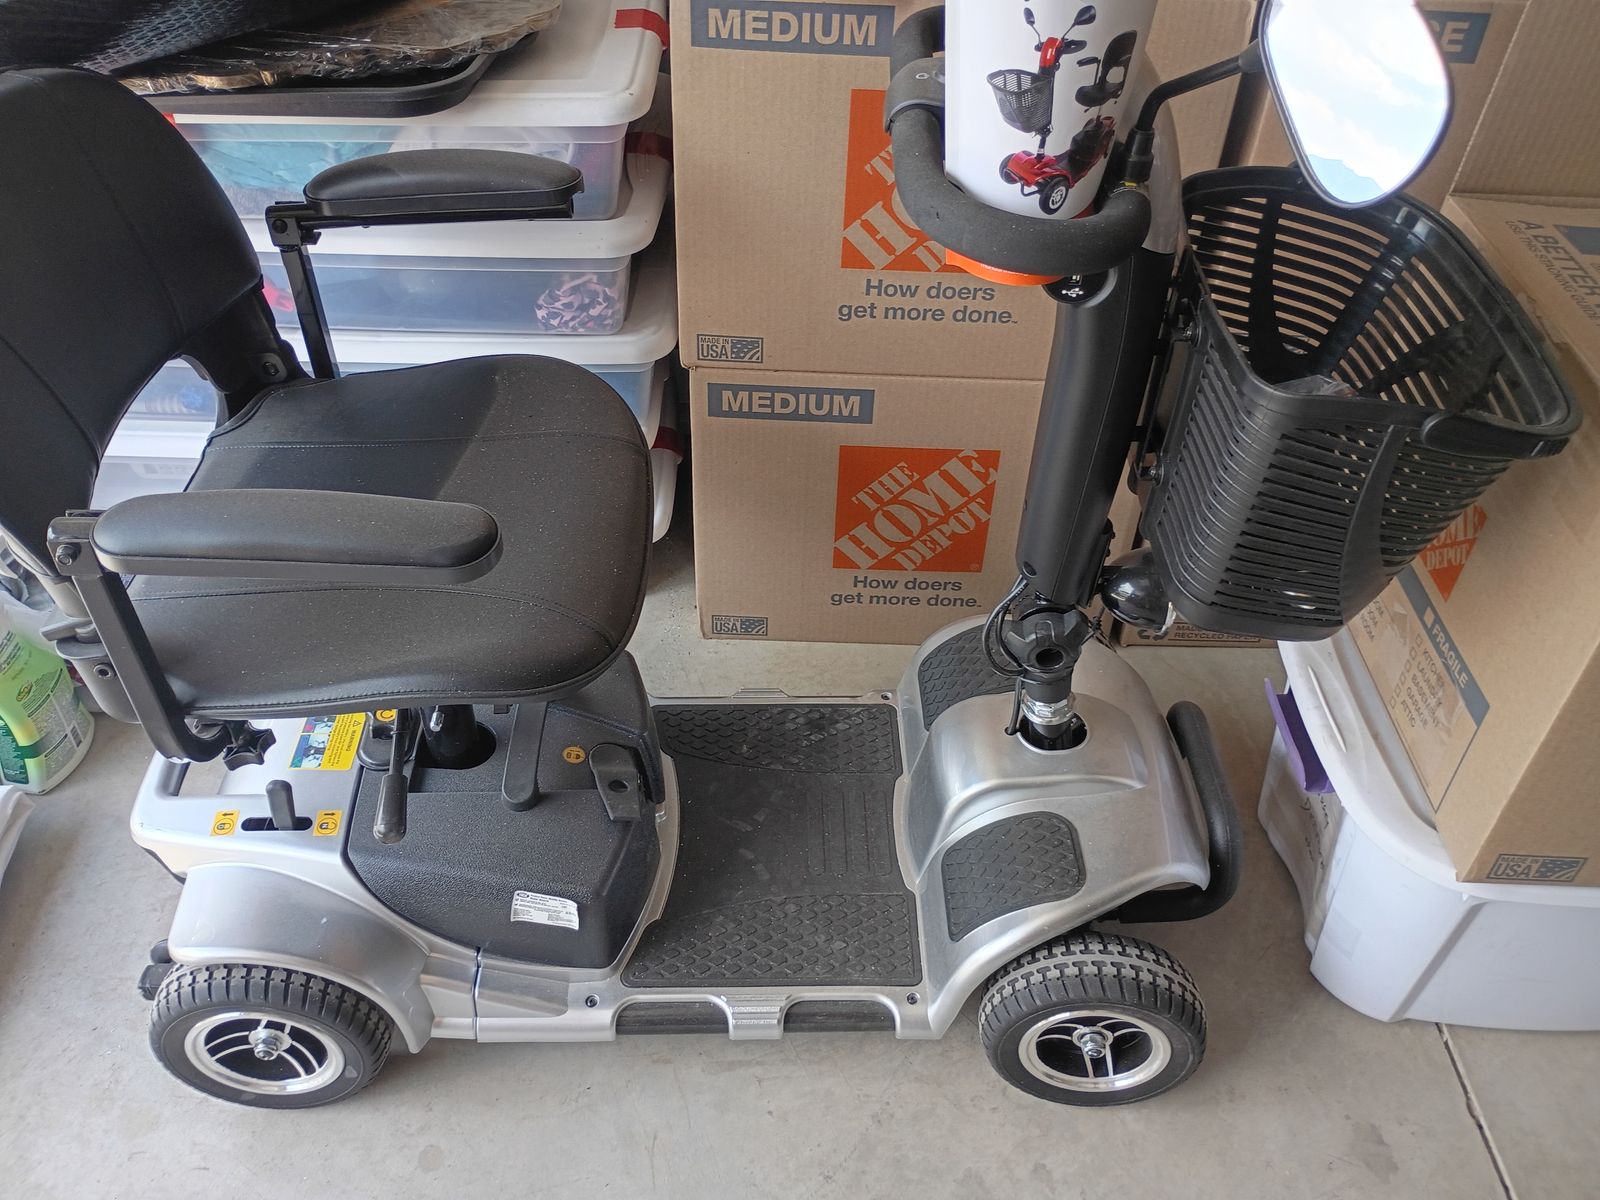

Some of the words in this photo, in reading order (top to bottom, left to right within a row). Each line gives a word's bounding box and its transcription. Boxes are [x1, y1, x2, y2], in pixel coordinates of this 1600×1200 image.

[707, 7, 878, 46] MEDIUM
[1517, 220, 1545, 231] A
[864, 278, 920, 298] How
[926, 281, 996, 301] doers
[838, 302, 877, 321] get
[883, 307, 945, 322] more
[701, 344, 729, 359] USA
[721, 390, 861, 417] MEDIUM
[851, 461, 920, 512] THE
[833, 449, 998, 570] HOME
[891, 497, 992, 571] DEPOT
[1426, 543, 1473, 570] DEPOT
[853, 575, 898, 590] How
[904, 577, 963, 592] doers
[830, 592, 863, 606] get
[868, 595, 921, 606] more
[715, 621, 738, 632] USA
[1173, 631, 1225, 639] RECYCLED
[1431, 623, 1469, 689] FRAGILE
[1400, 700, 1417, 728] ATTIC
[1493, 864, 1532, 877] USA
